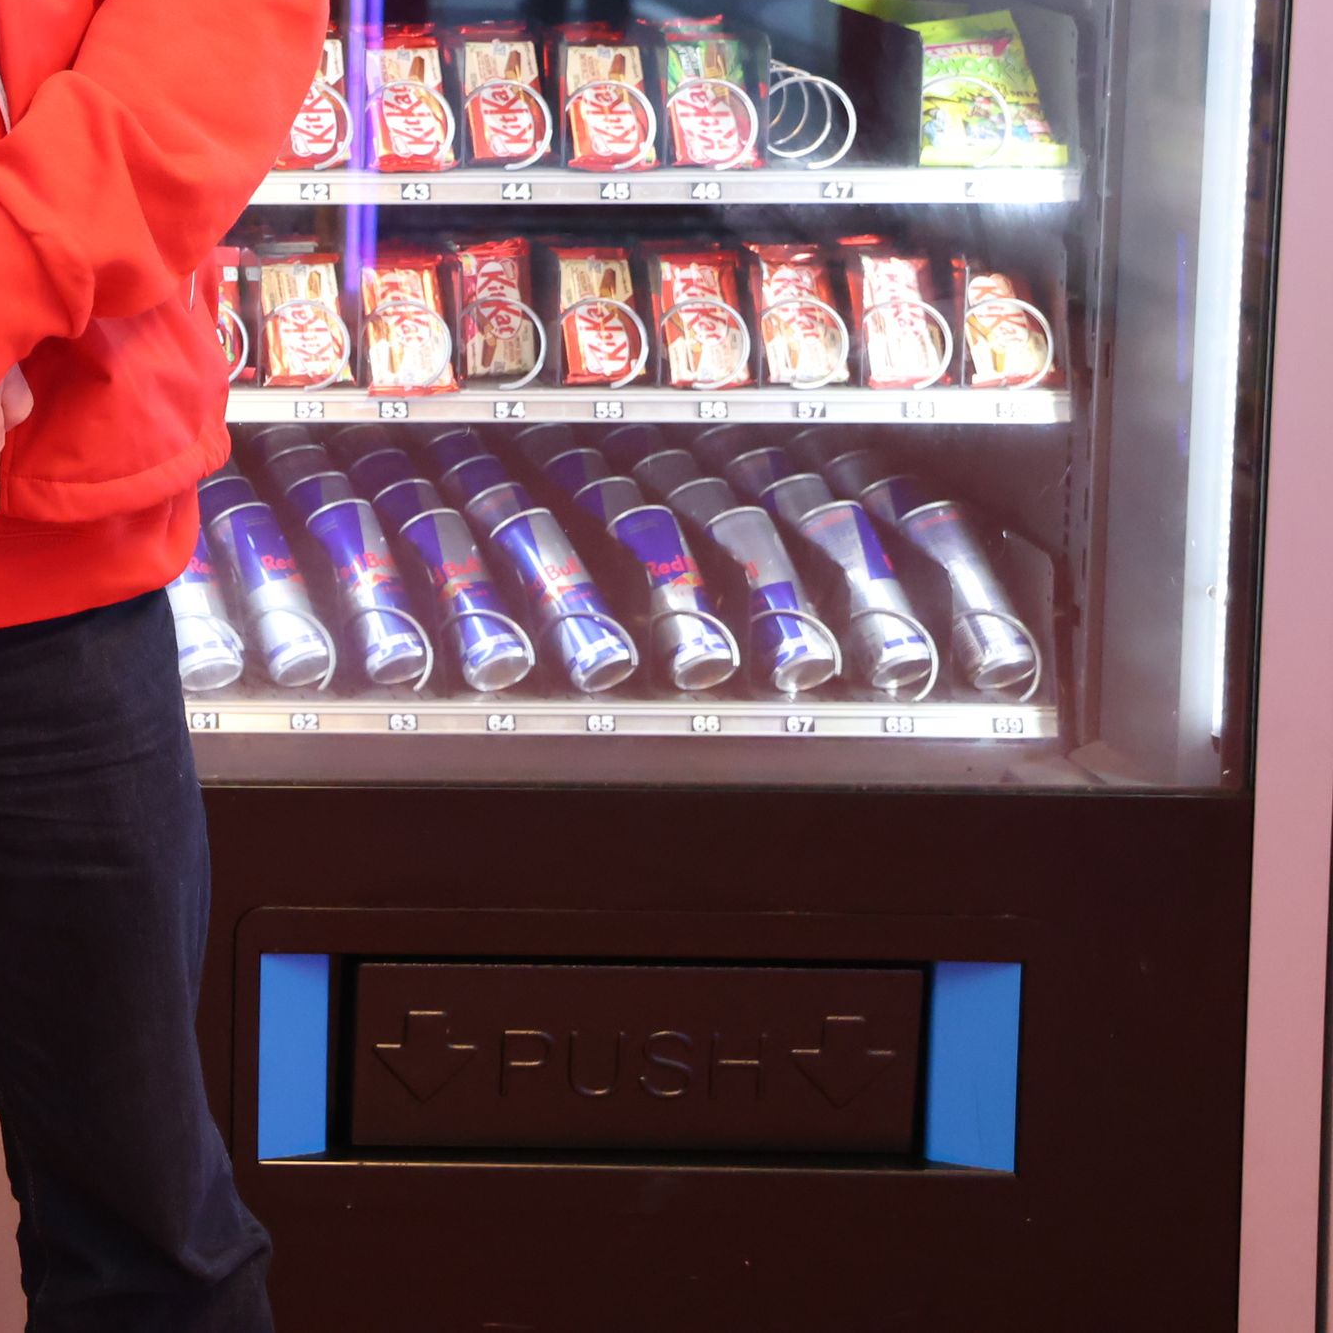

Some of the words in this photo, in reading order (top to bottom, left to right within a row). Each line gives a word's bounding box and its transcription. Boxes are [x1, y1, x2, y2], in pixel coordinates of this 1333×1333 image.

[300, 183, 330, 200] 42
[401, 183, 431, 200] 43
[502, 183, 532, 200] 44
[600, 182, 631, 200] 45
[295, 402, 324, 419] 52
[379, 401, 408, 419] 53
[494, 401, 525, 419] 54
[594, 401, 623, 418] 55
[544, 557, 582, 581] Bull
[646, 554, 686, 577] Red
[191, 713, 219, 730] 61
[290, 713, 319, 731] 62
[389, 714, 418, 731] 63
[487, 714, 515, 731] 64
[586, 715, 615, 732] 65
[691, 716, 722, 733] 66
[786, 716, 815, 733] 67
[500, 1029, 770, 1100] PUSH
